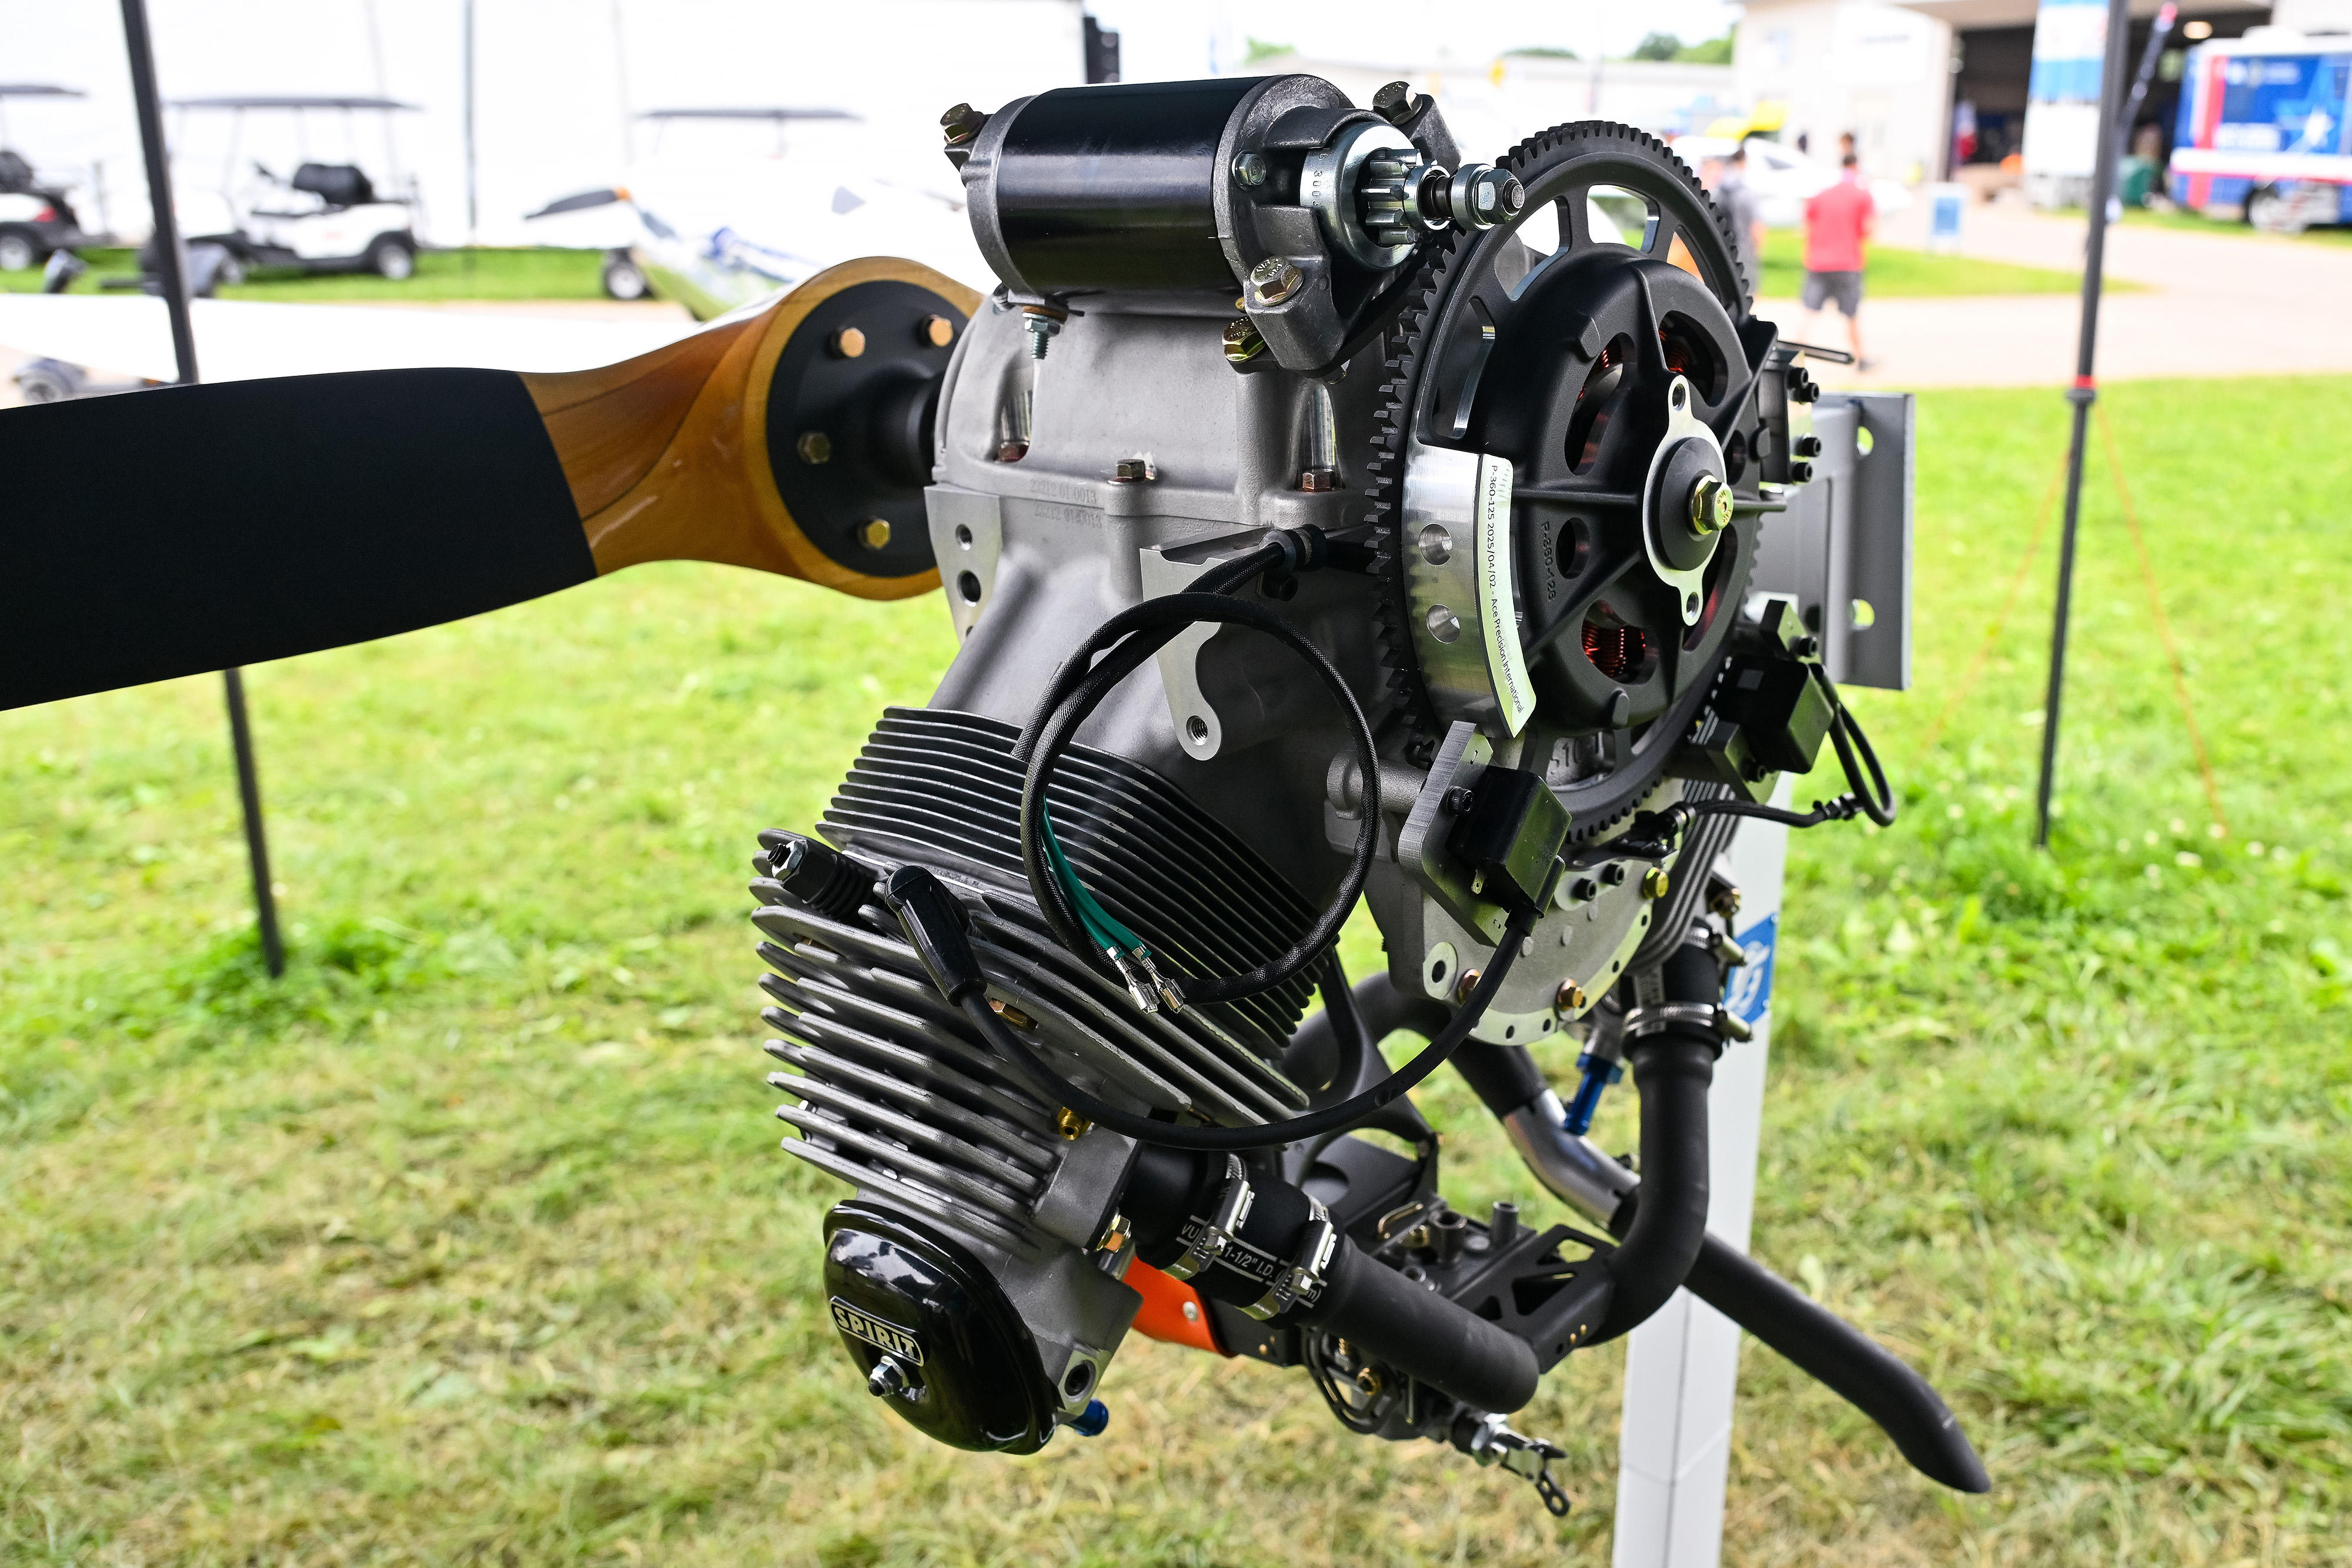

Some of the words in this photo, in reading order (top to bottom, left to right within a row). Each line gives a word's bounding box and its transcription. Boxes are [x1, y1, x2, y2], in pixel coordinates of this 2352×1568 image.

[1488, 465, 1498, 520] P-360-125
[1487, 523, 1496, 589] 2025/04/02
[1494, 618, 1506, 662] Precision
[1504, 660, 1524, 714] International
[834, 1306, 914, 1359] SPIRIT
